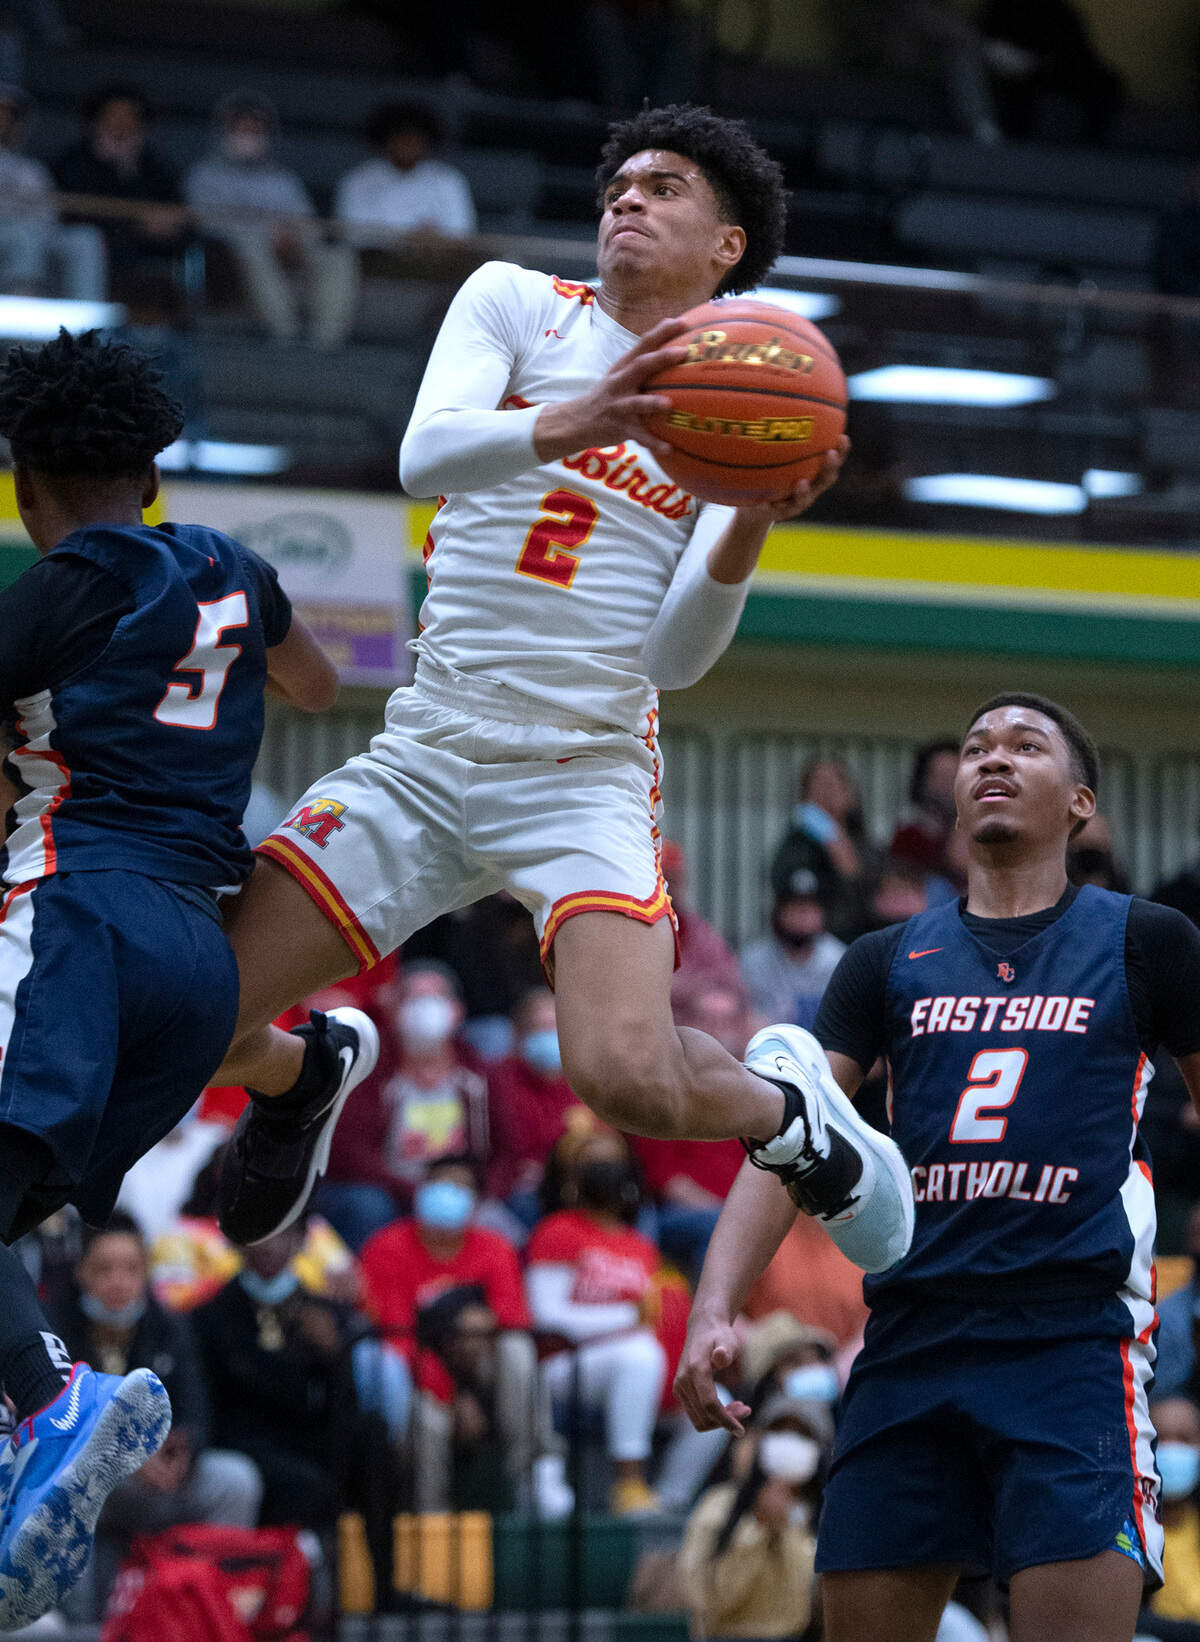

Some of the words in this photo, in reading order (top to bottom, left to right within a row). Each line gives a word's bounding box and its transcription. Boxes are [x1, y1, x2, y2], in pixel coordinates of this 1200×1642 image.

[514, 487, 601, 590] 2
[153, 590, 249, 731] 5
[911, 995, 1095, 1037] EASTSIDE
[949, 1047, 1028, 1144] 2
[909, 1160, 1079, 1203] CATHOLIC
